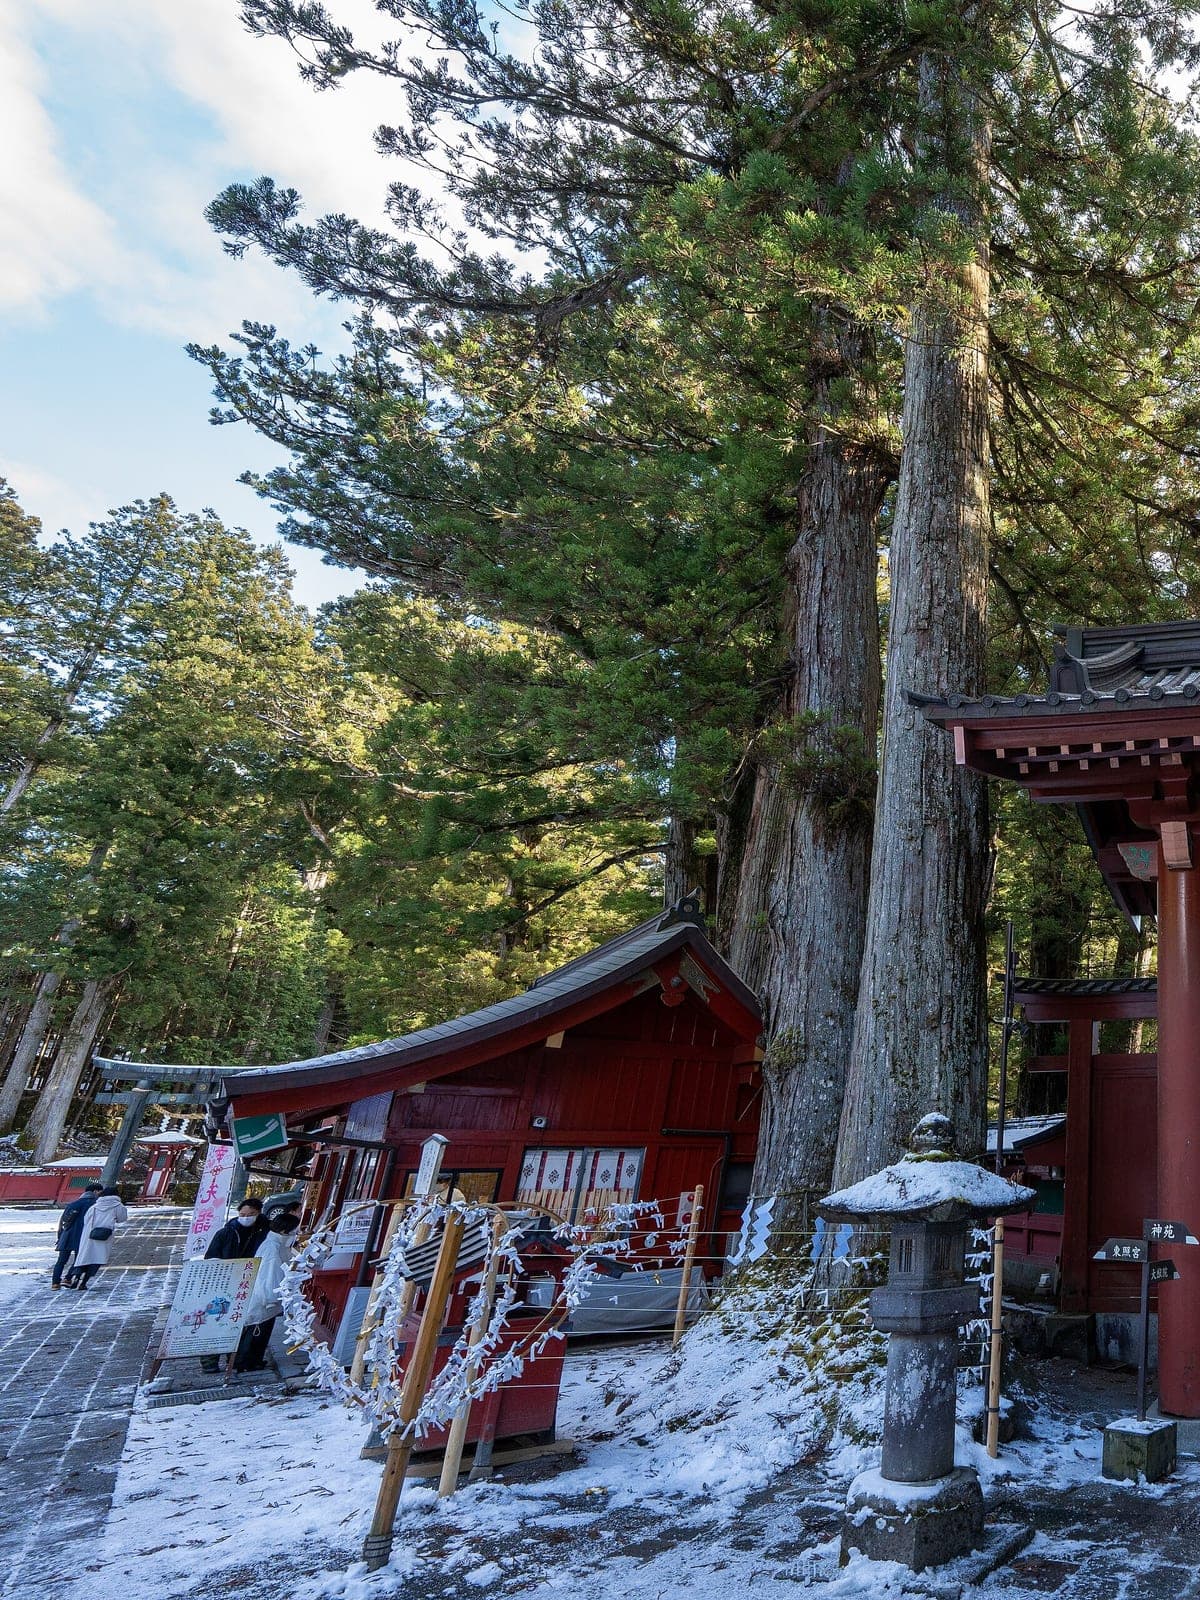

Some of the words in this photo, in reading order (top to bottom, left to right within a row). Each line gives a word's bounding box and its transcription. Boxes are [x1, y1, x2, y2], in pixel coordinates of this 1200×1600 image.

[1151, 1223, 1175, 1239] 神苑
[1112, 1244, 1141, 1259] 東照宮
